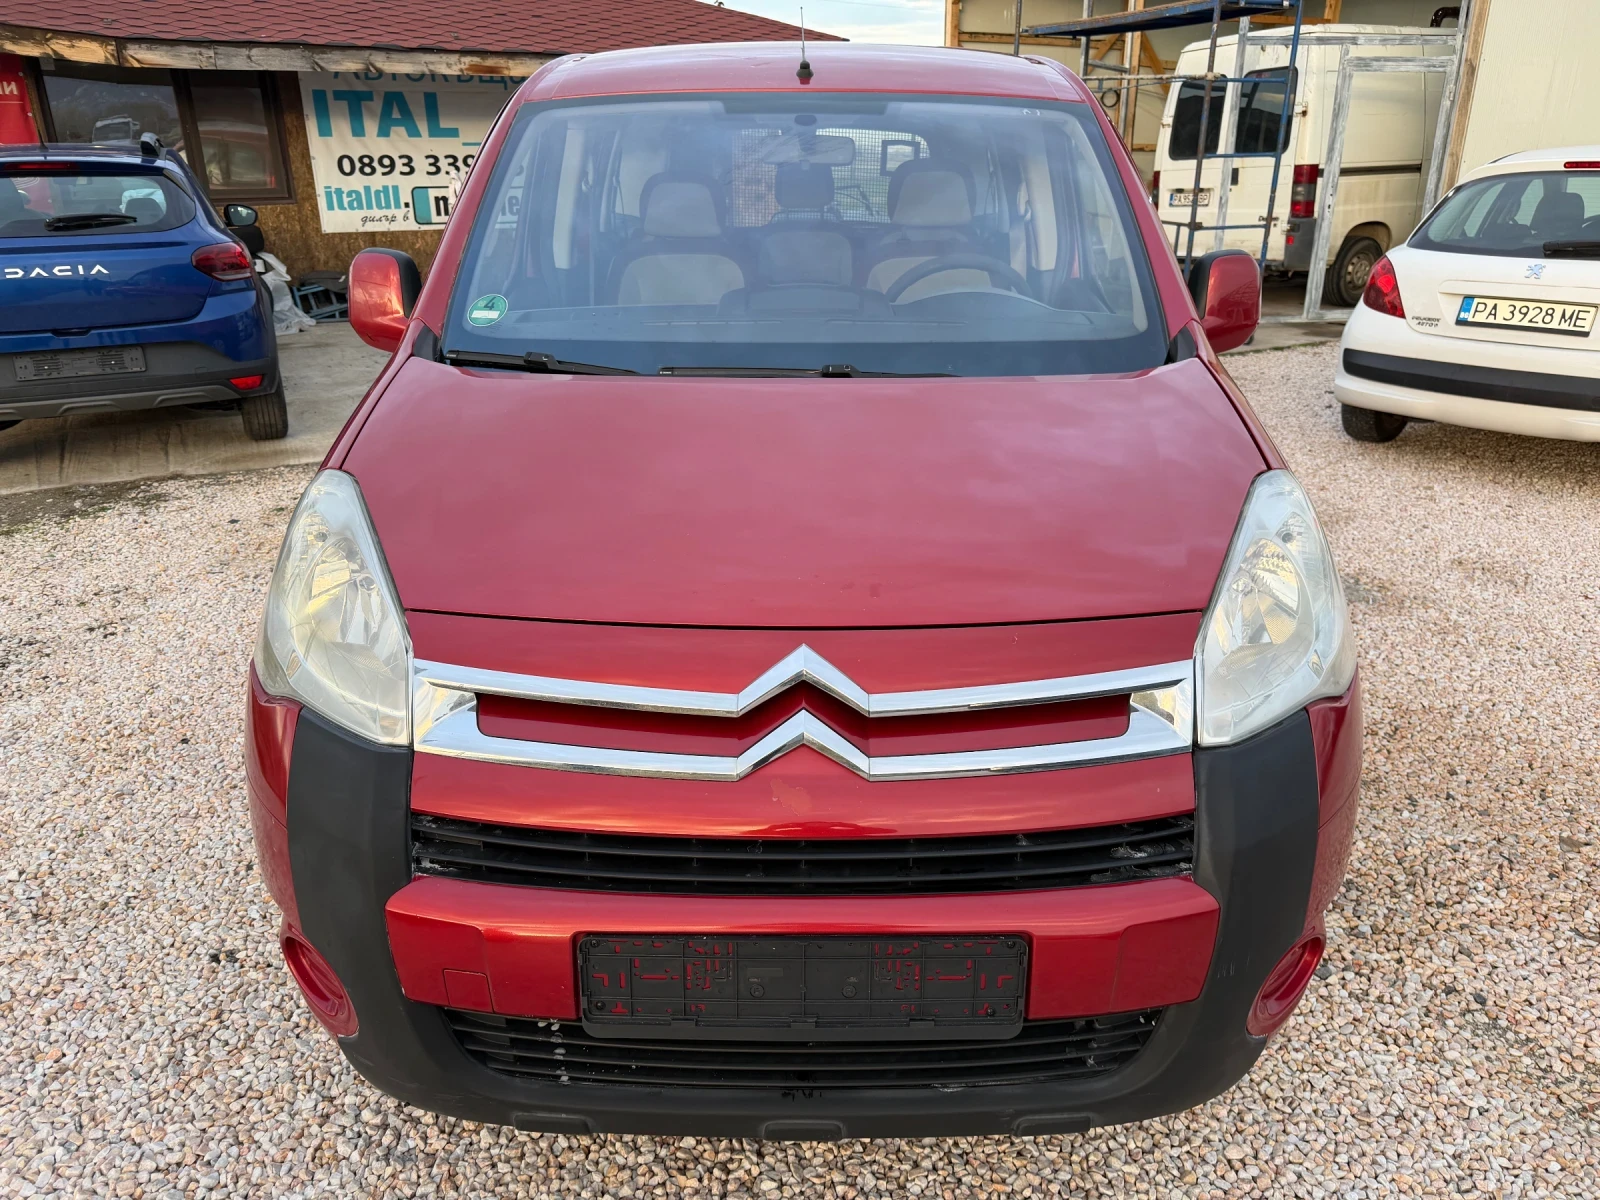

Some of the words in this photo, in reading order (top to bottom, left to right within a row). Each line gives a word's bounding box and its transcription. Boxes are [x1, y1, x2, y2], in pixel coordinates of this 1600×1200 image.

[337, 154, 416, 177] 0893
[4, 264, 110, 279] DACIA
[483, 296, 497, 310] 4
[1472, 302, 1498, 320] PA
[1502, 304, 1556, 325] 3928
[1557, 308, 1591, 328] ME
